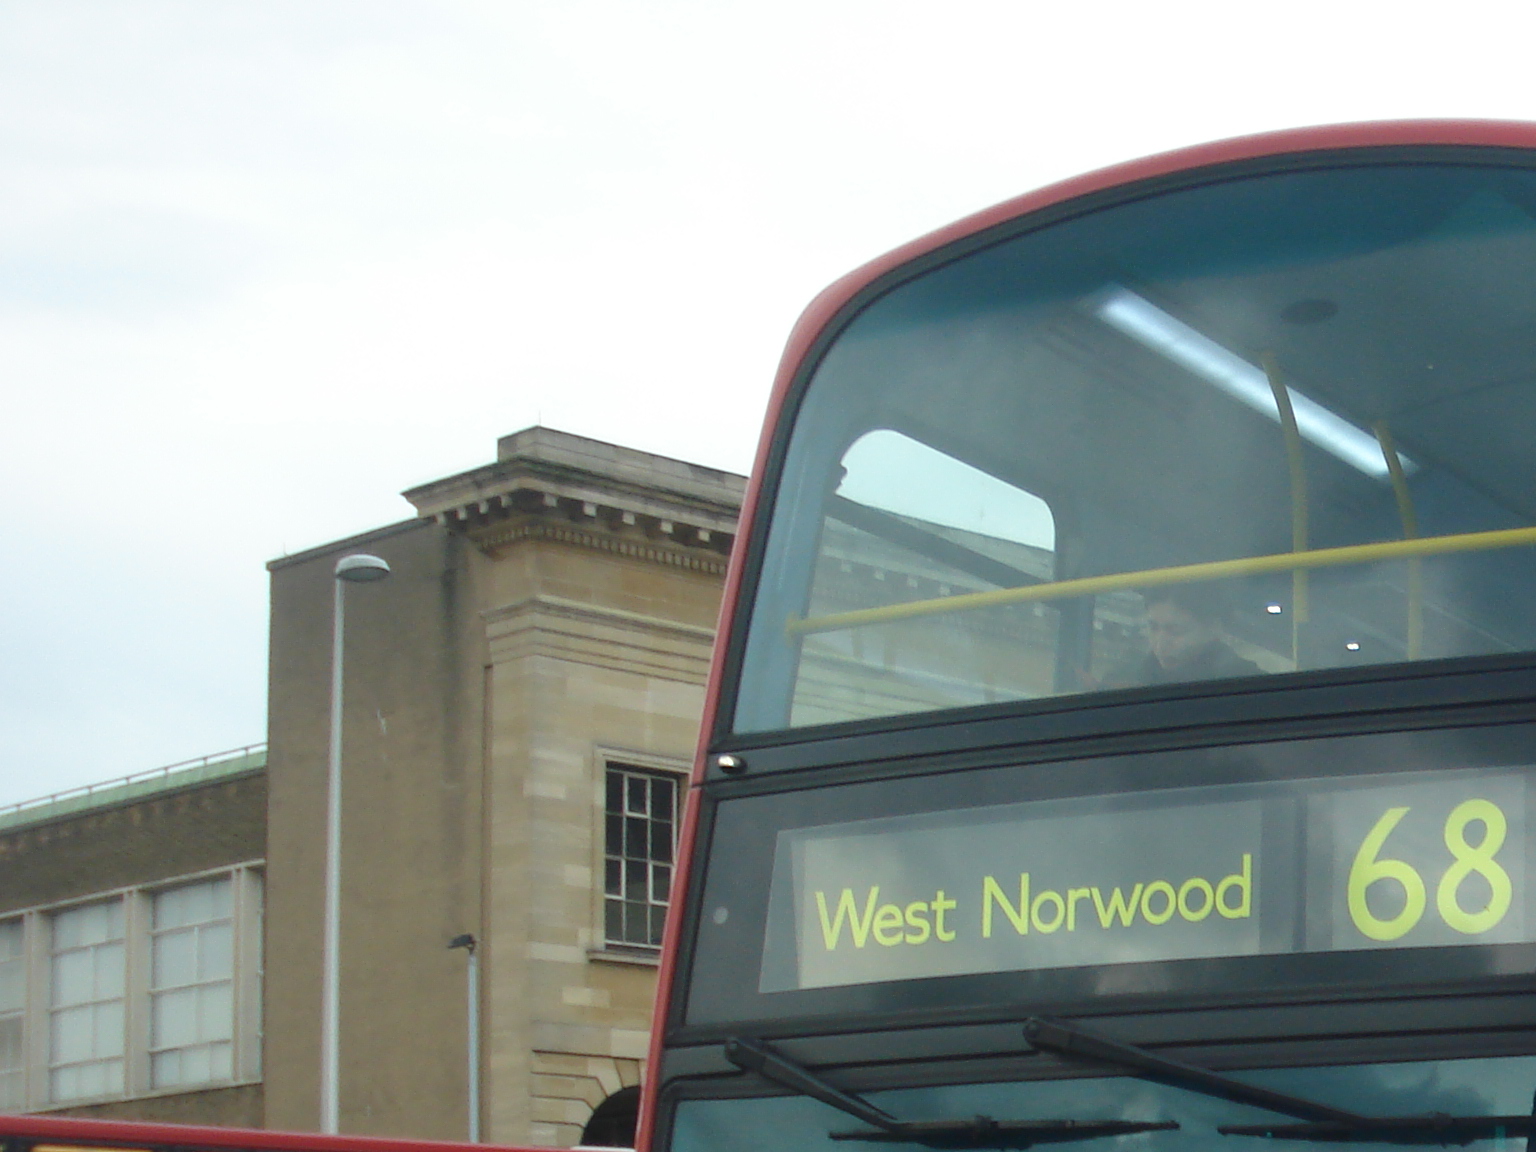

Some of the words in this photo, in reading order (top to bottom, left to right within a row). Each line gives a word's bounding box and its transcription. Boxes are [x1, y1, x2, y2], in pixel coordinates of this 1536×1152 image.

[815, 886, 957, 950] West
[982, 853, 1252, 939] Norwood
[1347, 798, 1513, 941] 68
